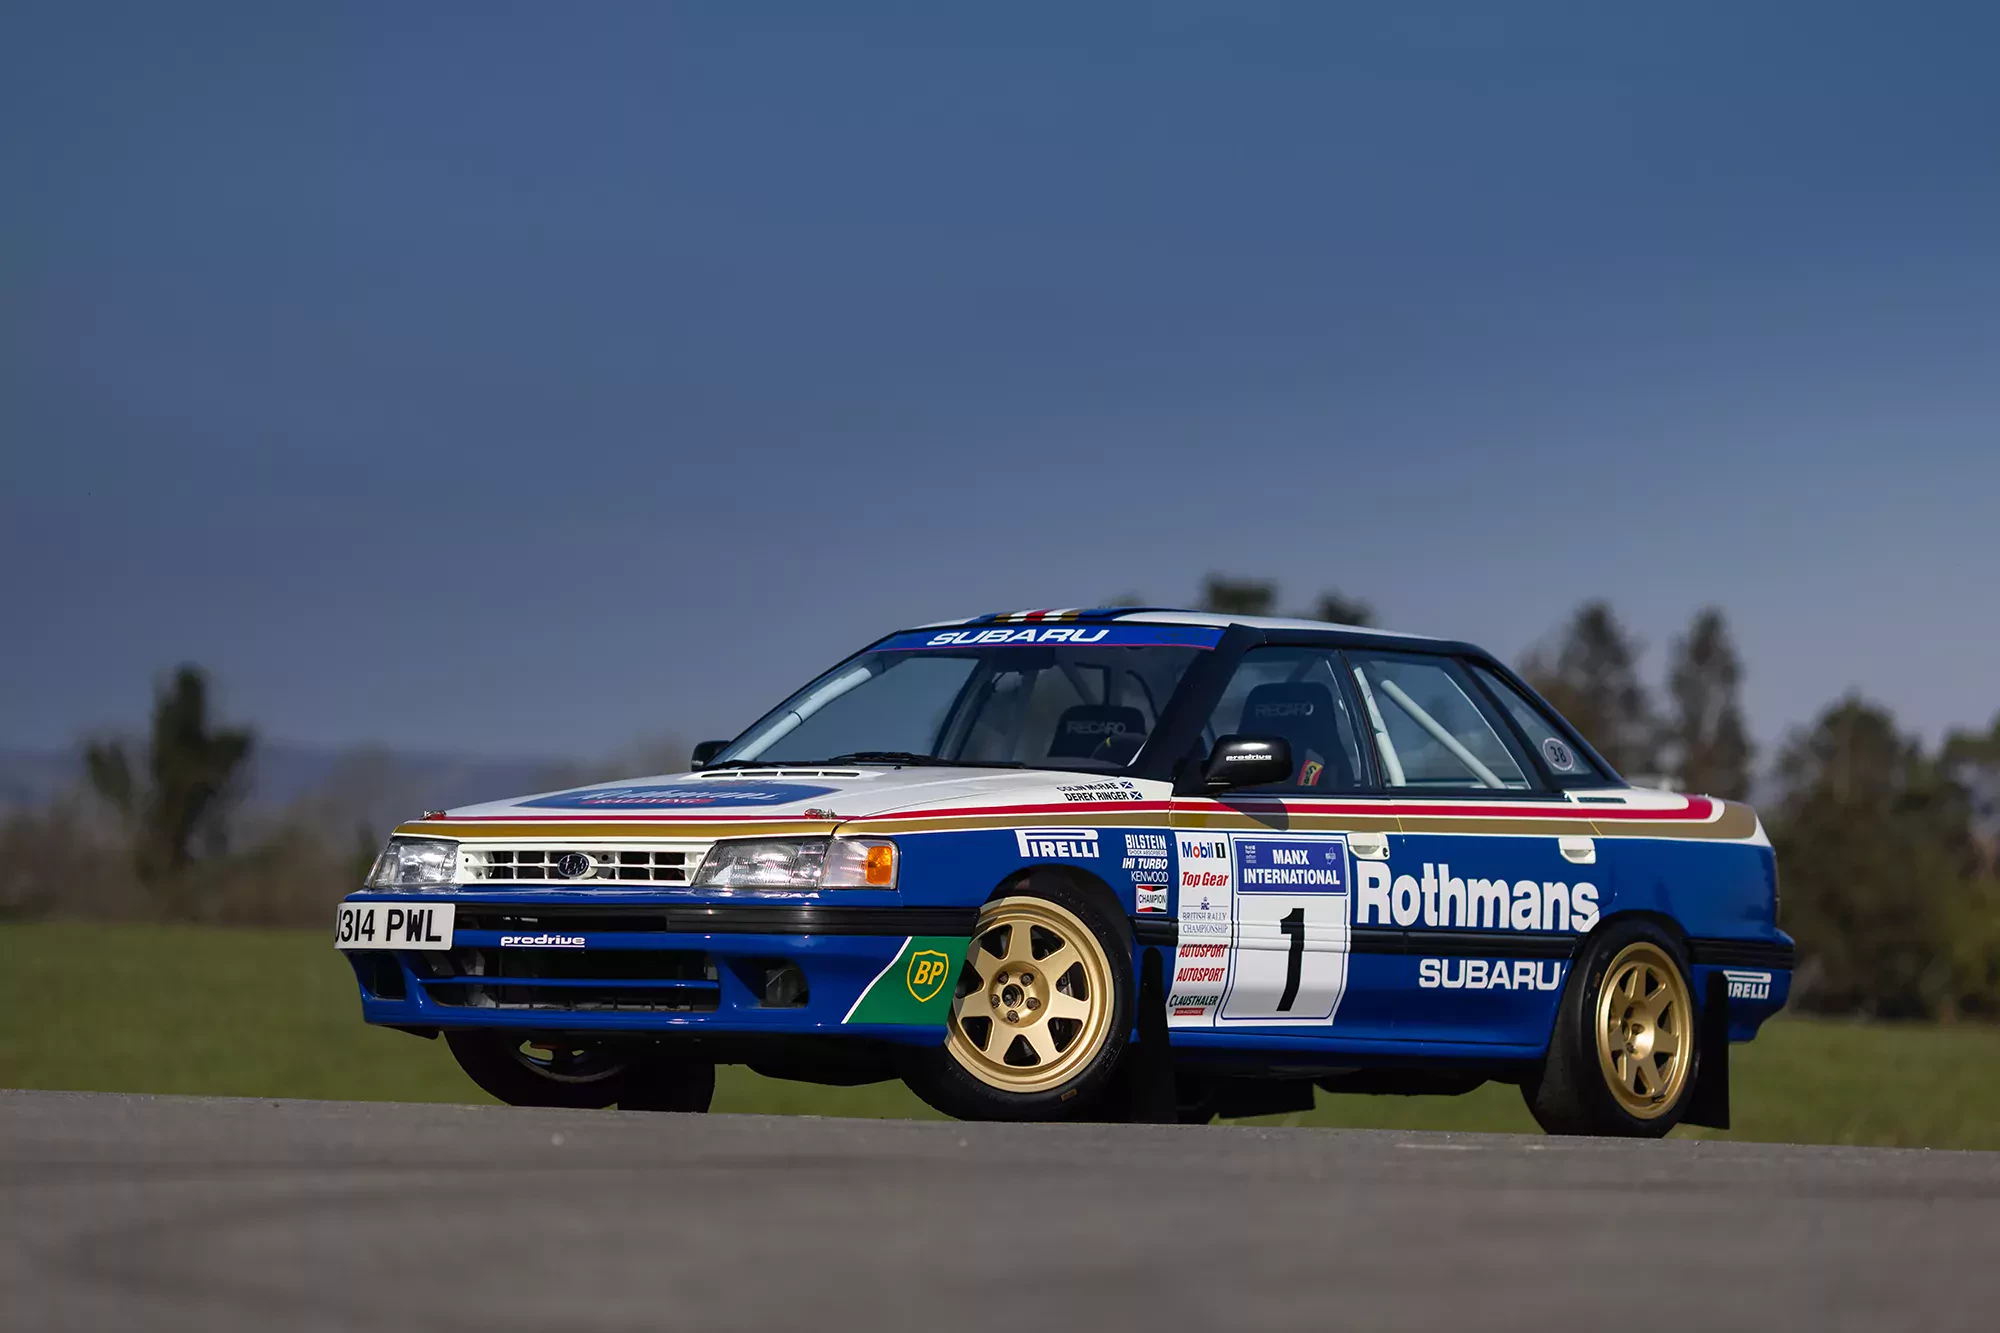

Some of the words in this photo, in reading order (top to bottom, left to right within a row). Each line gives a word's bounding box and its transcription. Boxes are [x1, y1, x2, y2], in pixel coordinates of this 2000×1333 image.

[927, 628, 1109, 646] SUBARU
[1066, 720, 1126, 735] RECARO
[1550, 746, 1567, 763] 38
[1064, 792, 1096, 801] DEREK
[1097, 791, 1129, 801] RINGER
[1015, 829, 1100, 858] PIRELLI
[1125, 834, 1167, 850] BILSTEIN
[1181, 841, 1214, 859] Mobil
[1215, 842, 1226, 858] 1
[1122, 858, 1135, 869] IHI
[1138, 858, 1168, 870] TURBO
[1272, 849, 1310, 865] MANX
[1131, 871, 1169, 882] KENWOOD
[1182, 871, 1200, 888] Top
[1202, 872, 1229, 886] Gear
[1243, 868, 1340, 885] INTERNATIONAL
[1138, 894, 1166, 904] CHAMPION
[1356, 860, 1600, 933] Rothmans
[1182, 912, 1205, 921] BRITISH
[1207, 912, 1227, 921] RALLY
[386, 909, 442, 942] PWL
[1182, 923, 1228, 933] CHAMPIONSHIP
[501, 934, 585, 947] prodrive
[1179, 943, 1228, 957] AUTOSPORT
[1276, 907, 1305, 1012] 1
[913, 961, 945, 985] BP
[1175, 967, 1225, 982] AUTOSPORT
[1419, 958, 1561, 991] SUBARU
[1169, 994, 1219, 1007] CLAUSTHALER
